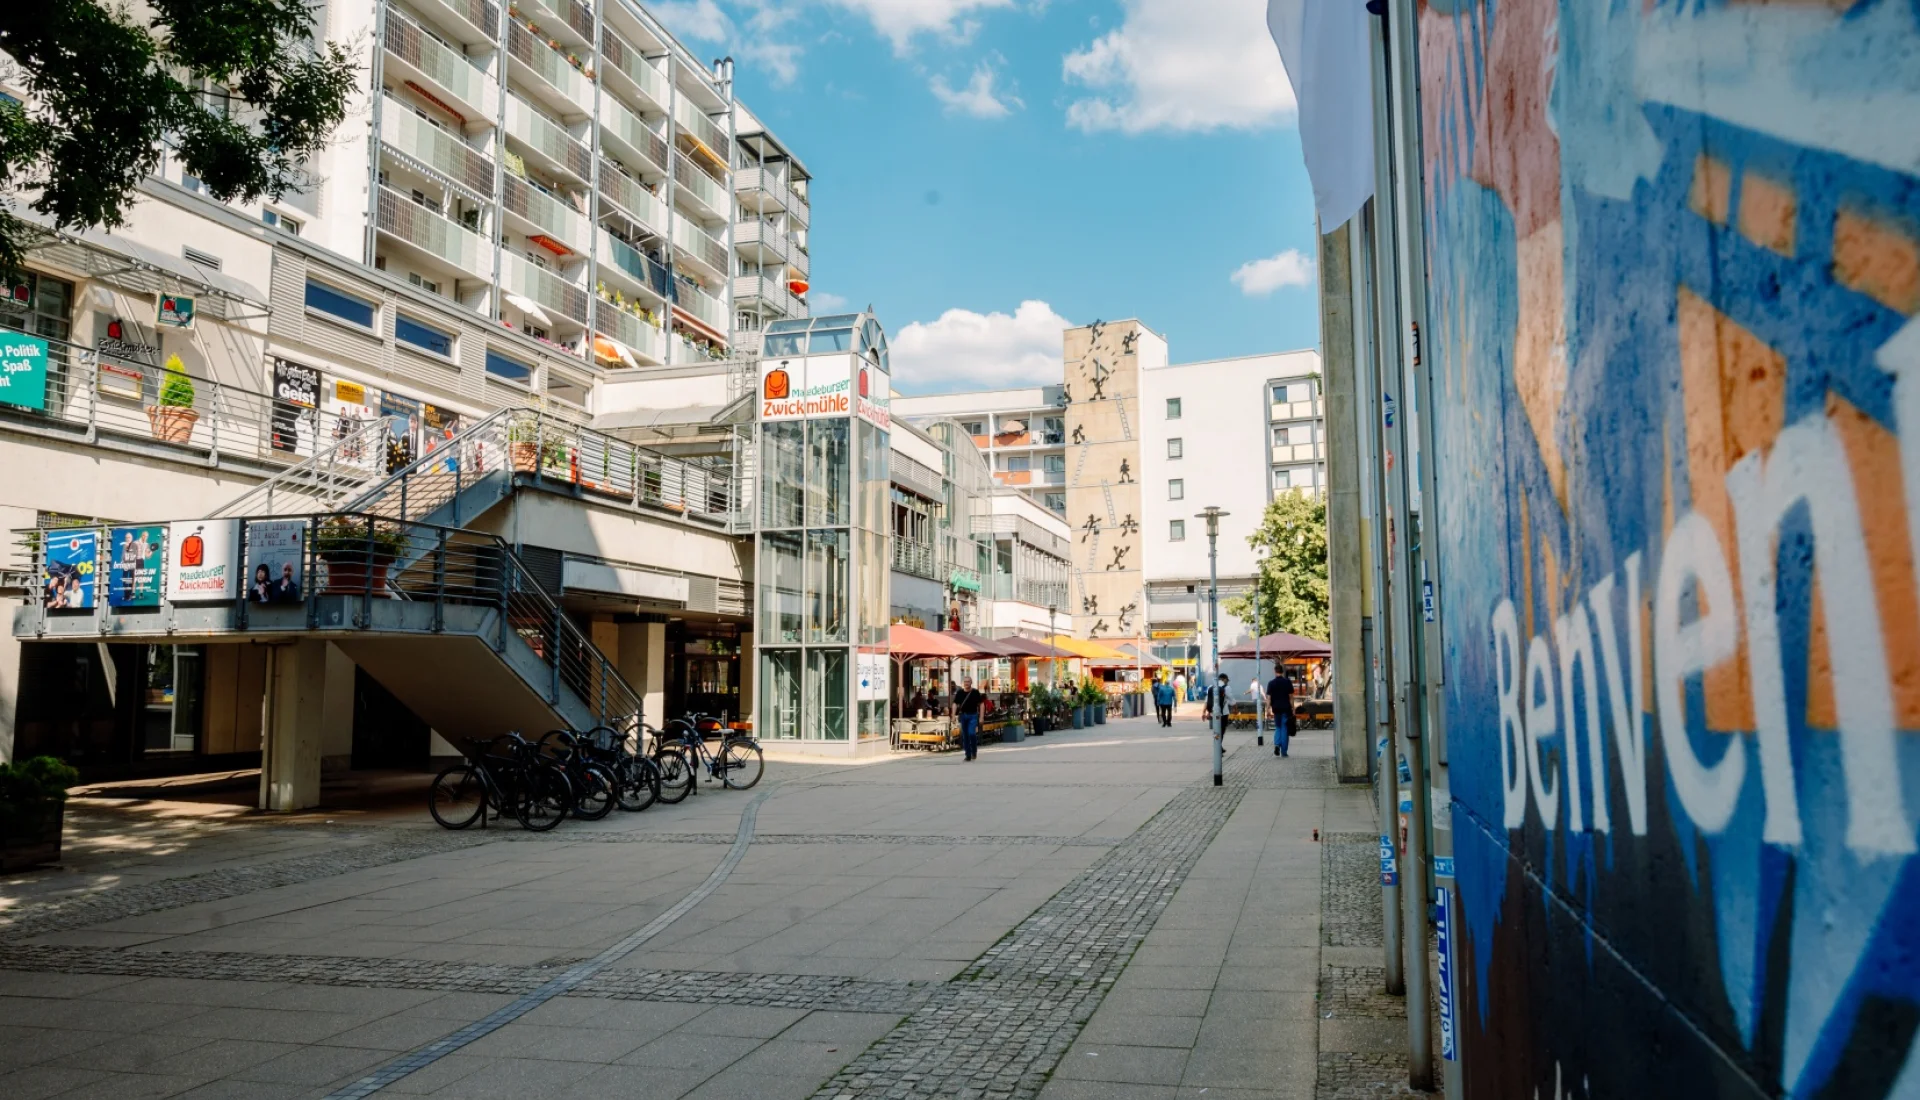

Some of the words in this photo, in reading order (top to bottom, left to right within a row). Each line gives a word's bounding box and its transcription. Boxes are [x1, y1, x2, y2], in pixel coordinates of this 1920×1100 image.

[5, 344, 41, 357] Politik
[2, 359, 32, 375] Spaß
[279, 383, 316, 406] Geist
[763, 394, 849, 417] Zwickmühle
[179, 577, 225, 590] Zwickmühle
